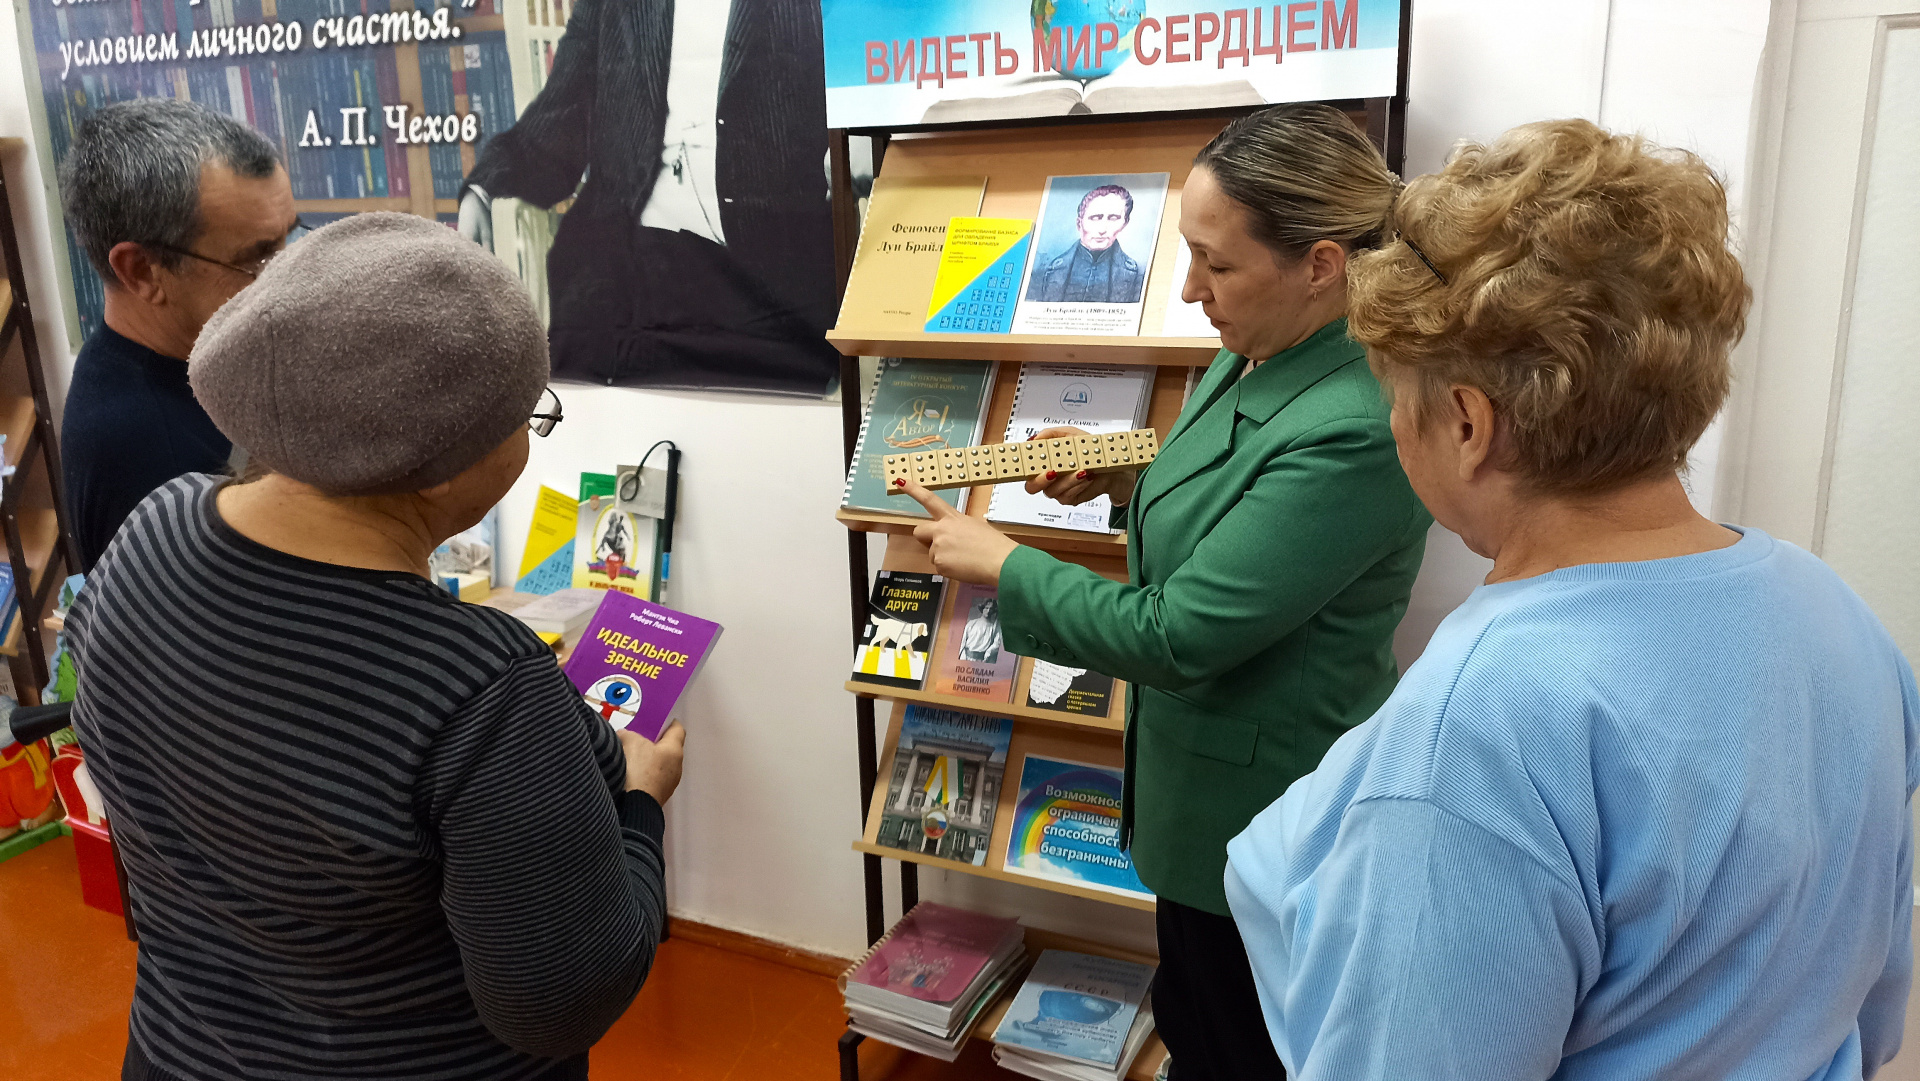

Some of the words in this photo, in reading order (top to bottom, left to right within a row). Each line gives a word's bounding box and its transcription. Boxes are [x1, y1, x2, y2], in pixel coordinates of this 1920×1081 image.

[59, 32, 179, 80] условием
[186, 21, 301, 58] личного
[312, 7, 461, 48] счастья.
[865, 32, 1019, 89] ВИДЕТЬ
[1032, 22, 1119, 73] МИР
[1133, 0, 1358, 69] СЕРДЦЕМ
[300, 109, 332, 147] А.
[340, 107, 376, 146] П.
[383, 105, 478, 144] Чехов
[892, 223, 946, 234] Феномен
[877, 241, 902, 254] Луи
[881, 585, 930, 601] Глазами
[885, 600, 919, 613] друга
[596, 627, 689, 668] ИДЕАЛЬНОЕ
[604, 650, 663, 680] ЗРЕНИЕ
[1041, 841, 1129, 869] безграничны
